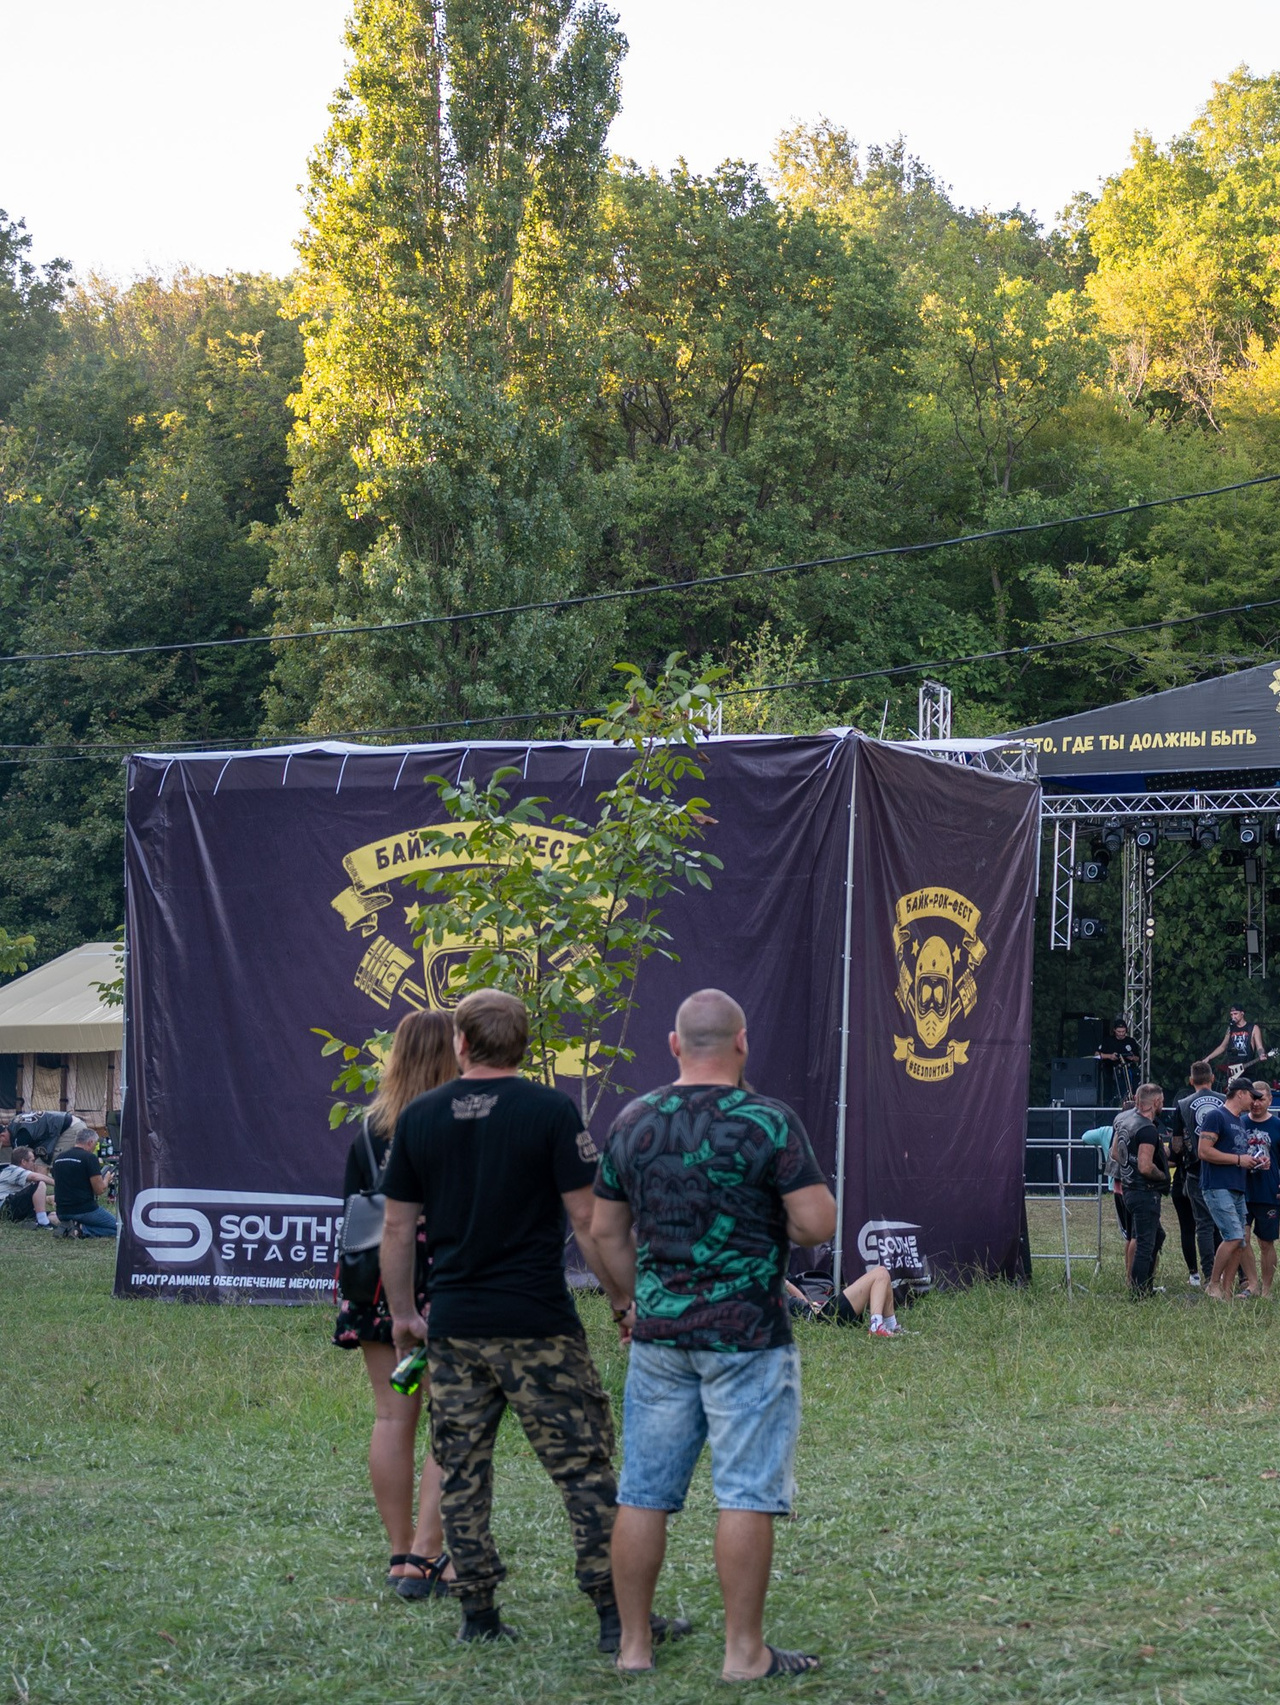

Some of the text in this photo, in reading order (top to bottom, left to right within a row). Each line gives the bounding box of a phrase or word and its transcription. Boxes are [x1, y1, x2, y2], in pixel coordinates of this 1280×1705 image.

[1002, 729, 1257, 754] ТО, ГДЕ ТЫ ДОЛЖНЫ БЫТЬ
[906, 890, 973, 923] БАЙК-РОК-ФЕСТ
[909, 1061, 950, 1078] #БЕЗПОНТОВ
[219, 1214, 332, 1243] SOUTH
[221, 1243, 329, 1263] STAGE
[131, 1273, 211, 1286] ПРОГРАММНОЕ
[213, 1275, 286, 1289] ОБЕСПЕЧЕНИЕ
